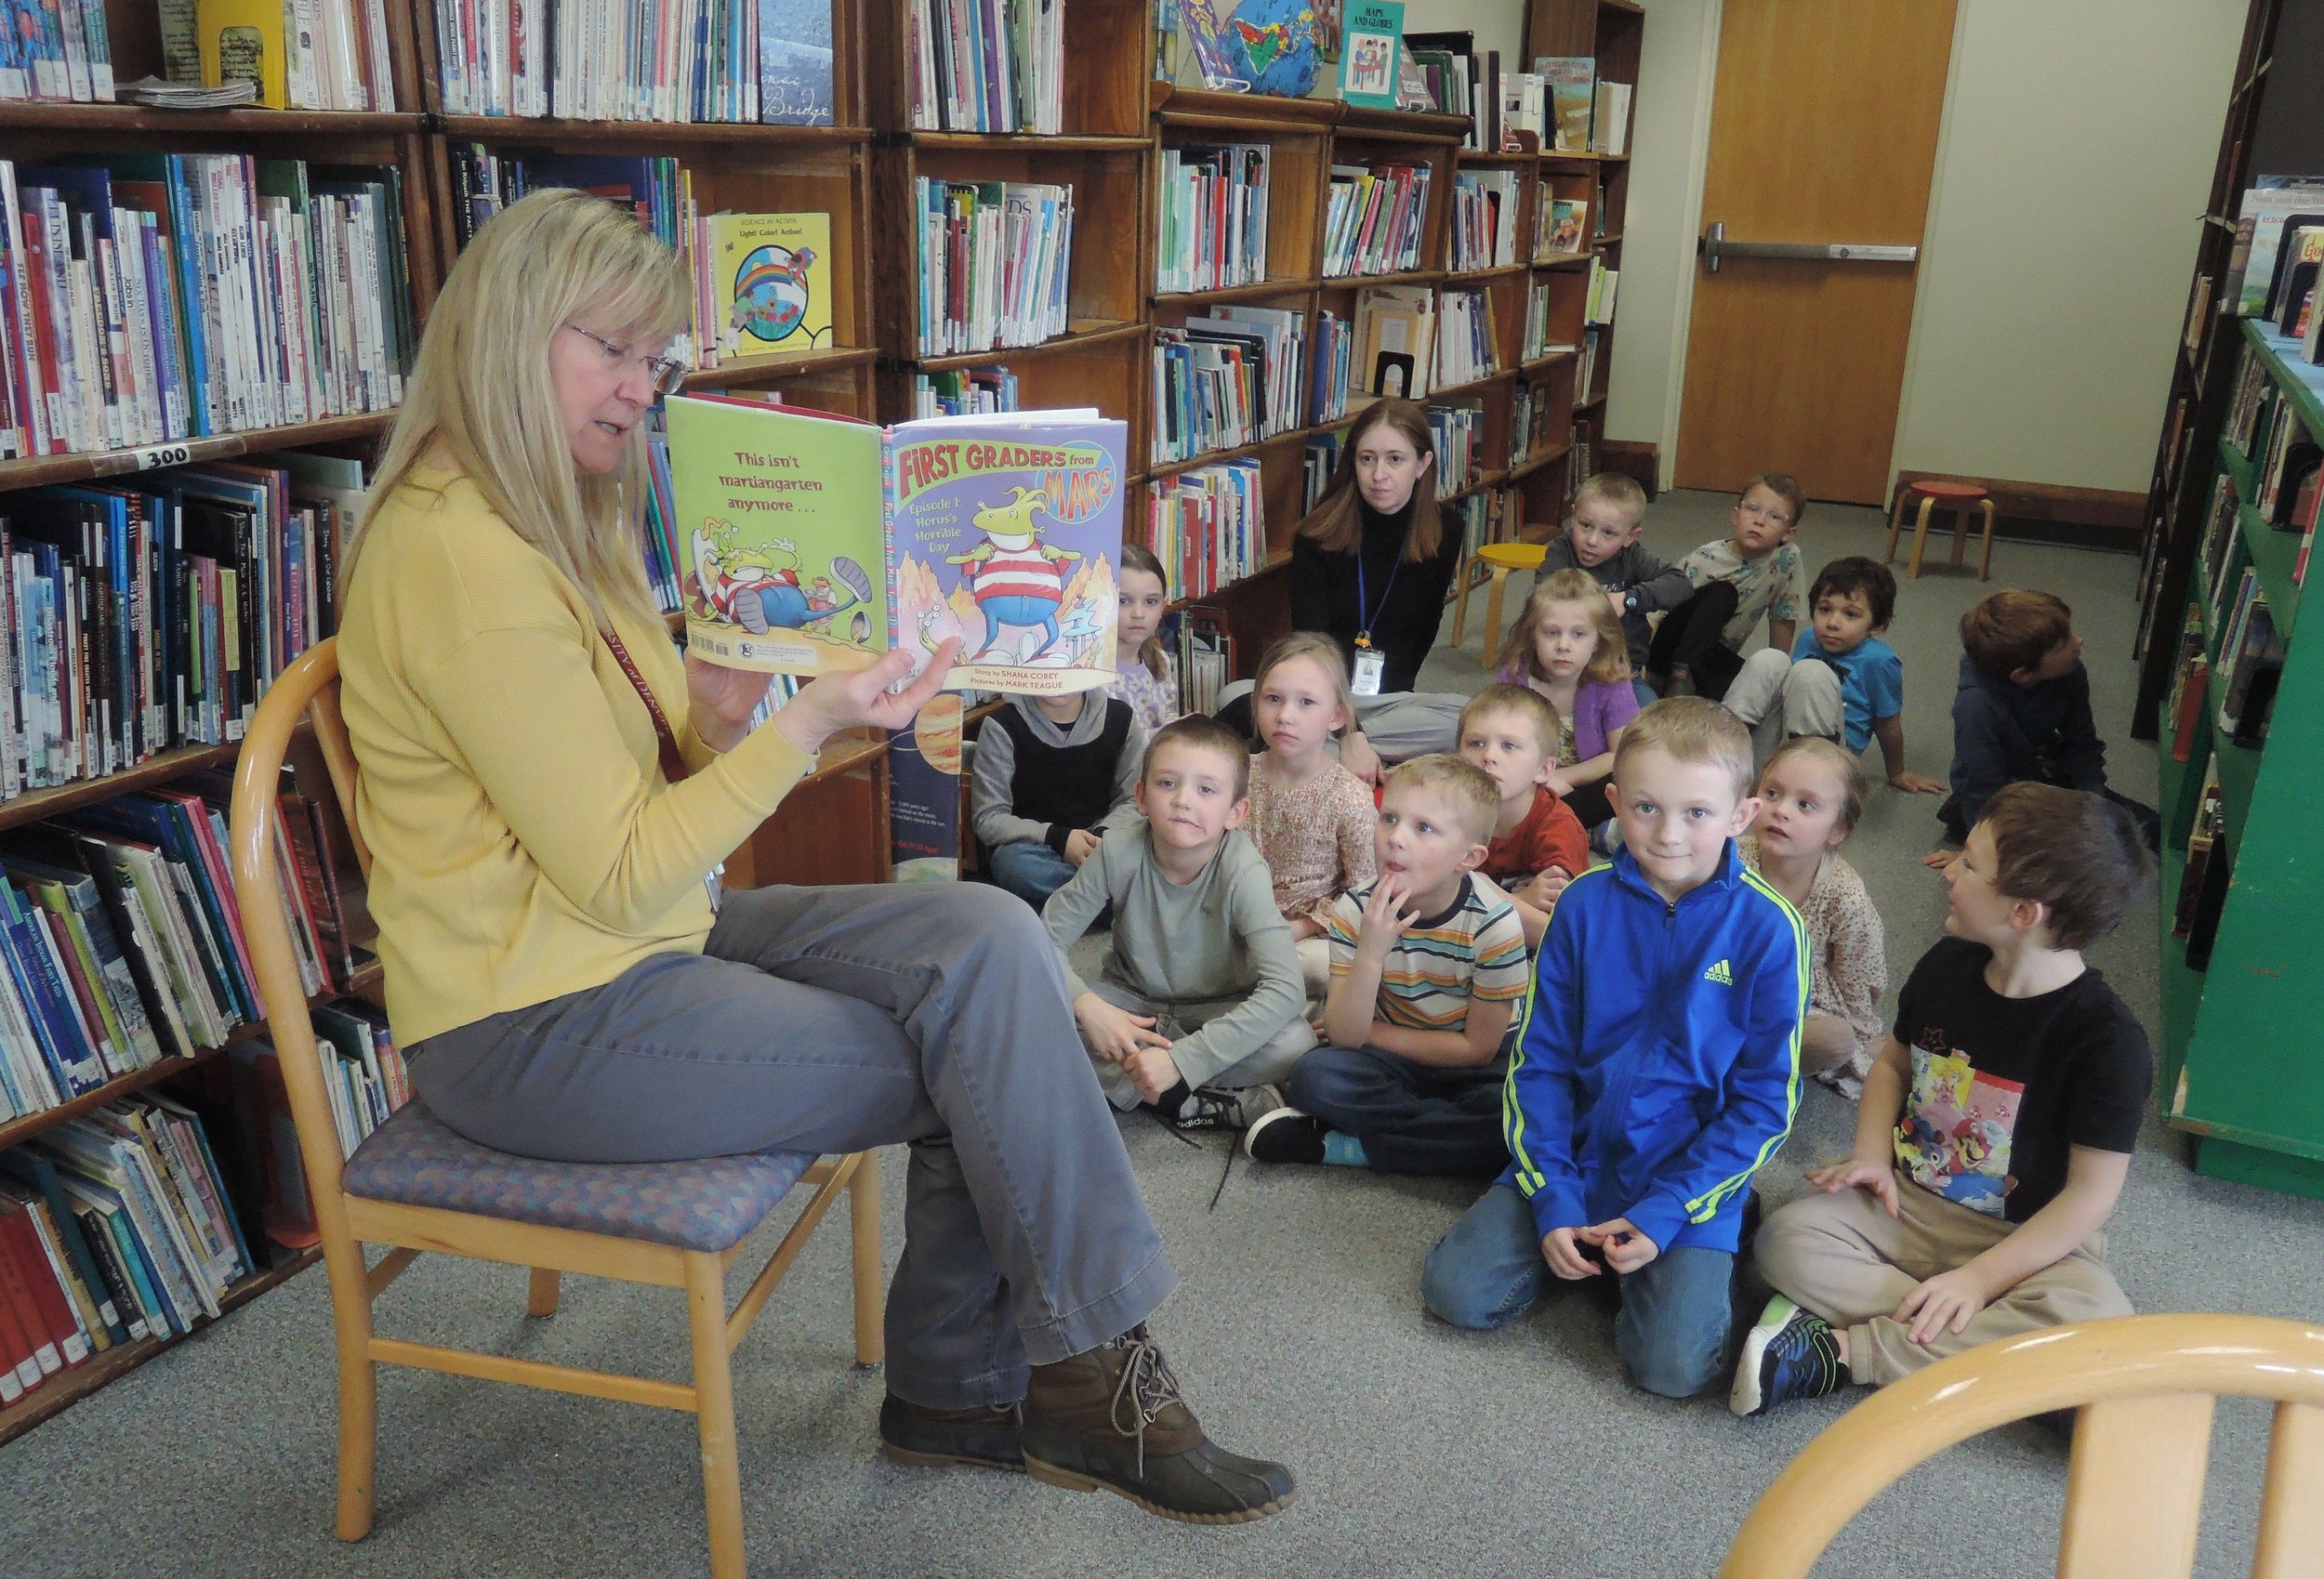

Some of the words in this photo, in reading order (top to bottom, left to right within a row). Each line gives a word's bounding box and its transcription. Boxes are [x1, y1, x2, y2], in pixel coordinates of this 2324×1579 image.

[1366, 7, 1383, 17] MAPS
[1355, 17, 1368, 26] AND
[762, 86, 829, 126] Bridge
[123, 277, 133, 298] Jobs
[127, 300, 134, 309] in
[24, 312, 33, 338] THEY
[26, 339, 35, 362] RUN
[101, 357, 112, 388] SONS
[147, 448, 187, 468] 300
[734, 452, 764, 467] This
[769, 454, 799, 468] isn't
[900, 444, 959, 500] FIRST
[965, 444, 1066, 470] GRADERS
[1070, 454, 1093, 465] from
[719, 476, 822, 493] martiangarten
[1042, 467, 1113, 520] MARS
[728, 498, 794, 513] anymore
[885, 502, 894, 518] First
[909, 499, 950, 515] Episode
[915, 515, 957, 528] Horus's
[885, 520, 894, 548] Graders
[915, 528, 961, 543] Horrible
[929, 543, 950, 555] Day
[886, 550, 894, 566] from
[887, 569, 895, 585] Mars
[974, 669, 992, 678] Story
[1001, 670, 1028, 678] SHANA
[1030, 671, 1060, 680] COREY
[970, 678, 996, 687] Pictures
[1005, 679, 1028, 689] MARK
[1029, 680, 1063, 690] TEAGUE
[1704, 972, 1733, 985] adidas
[1177, 1117, 1214, 1128] adidas
